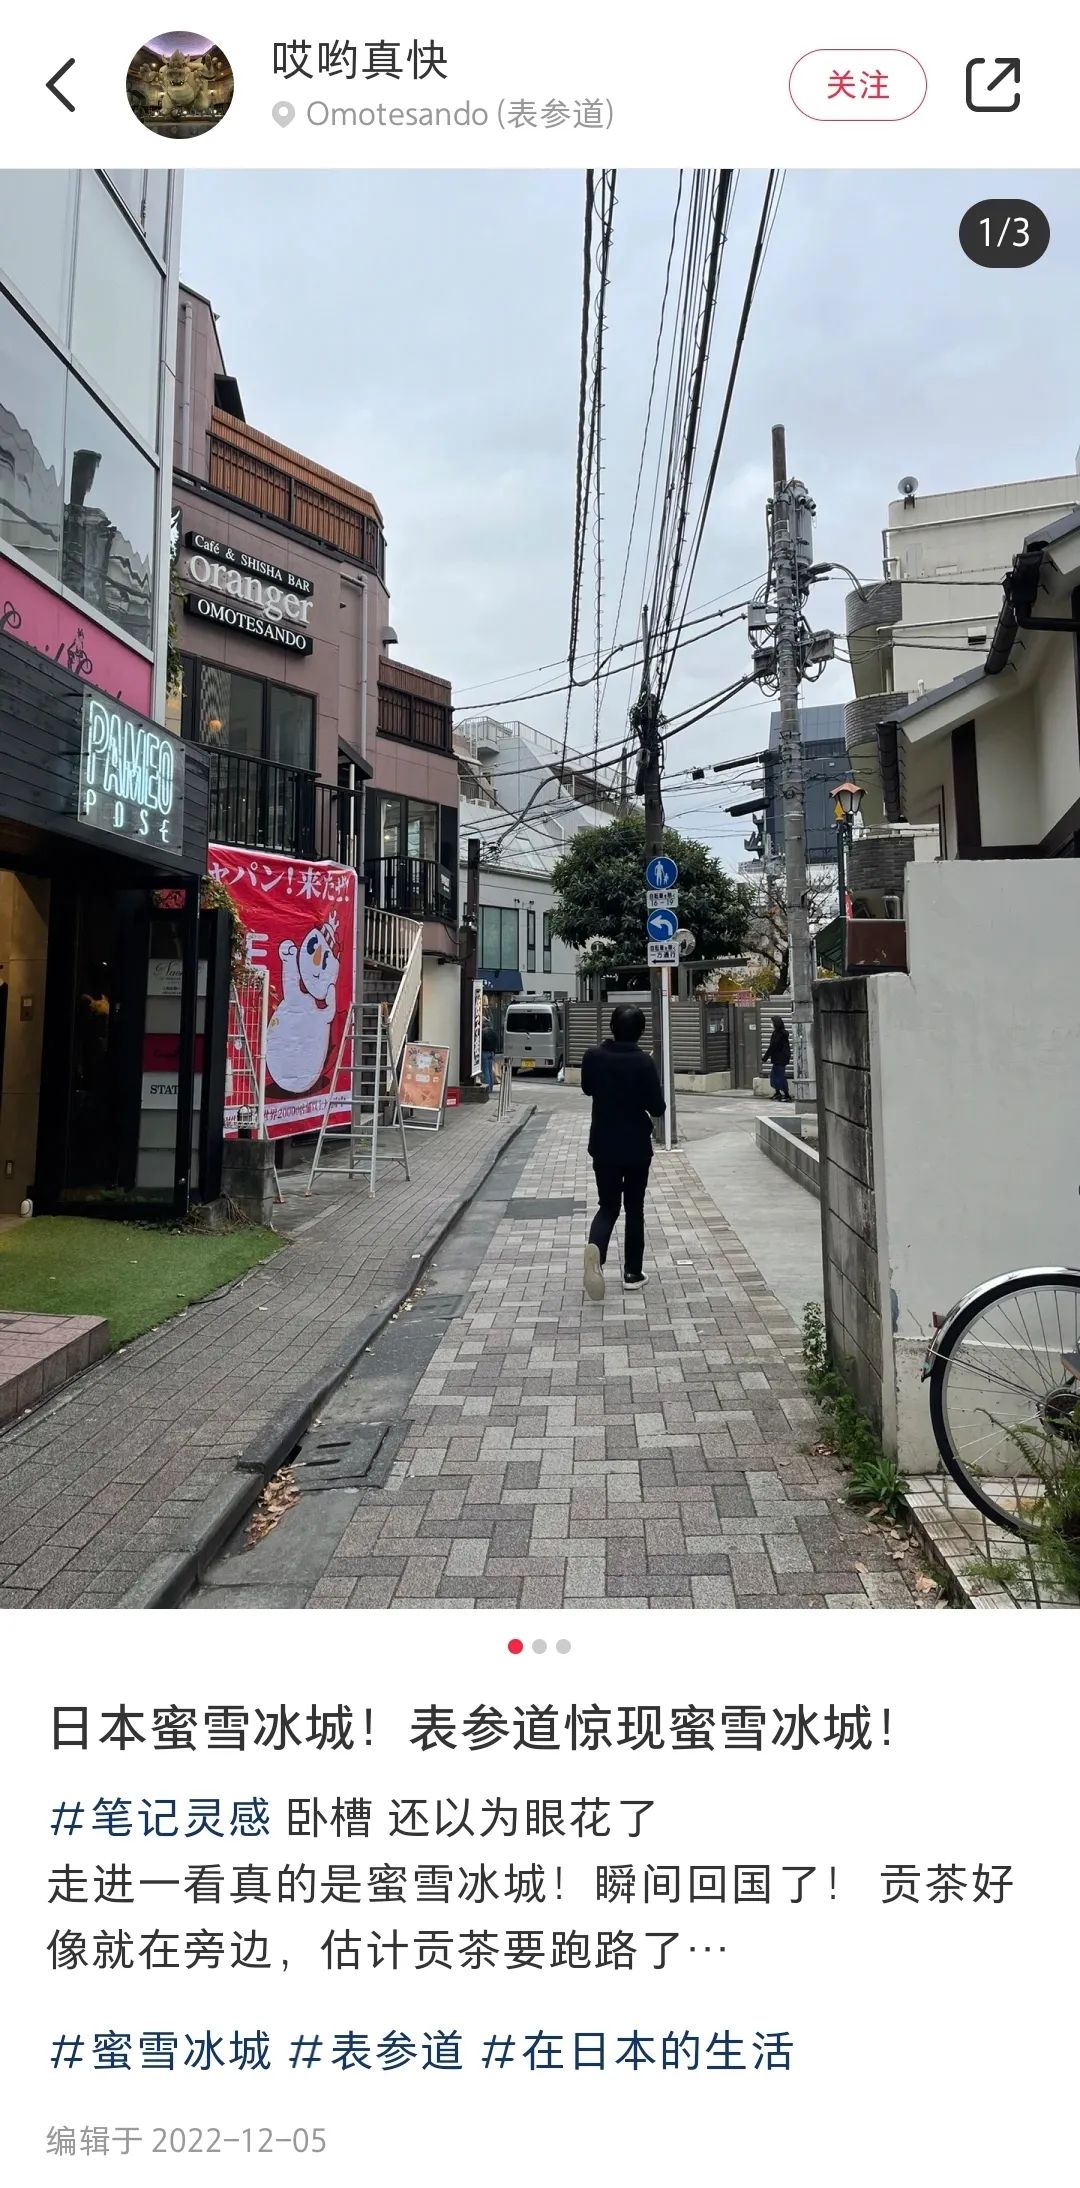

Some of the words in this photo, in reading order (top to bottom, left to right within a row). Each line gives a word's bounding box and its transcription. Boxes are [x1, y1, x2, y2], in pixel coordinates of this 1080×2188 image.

[189, 555, 313, 624] oranger
[194, 534, 220, 554] Café
[225, 547, 235, 561] &
[240, 554, 283, 581] SHISHA
[287, 573, 310, 592] BAR
[197, 599, 306, 650] OMOTESANDO
[86, 700, 174, 815] PAMEO
